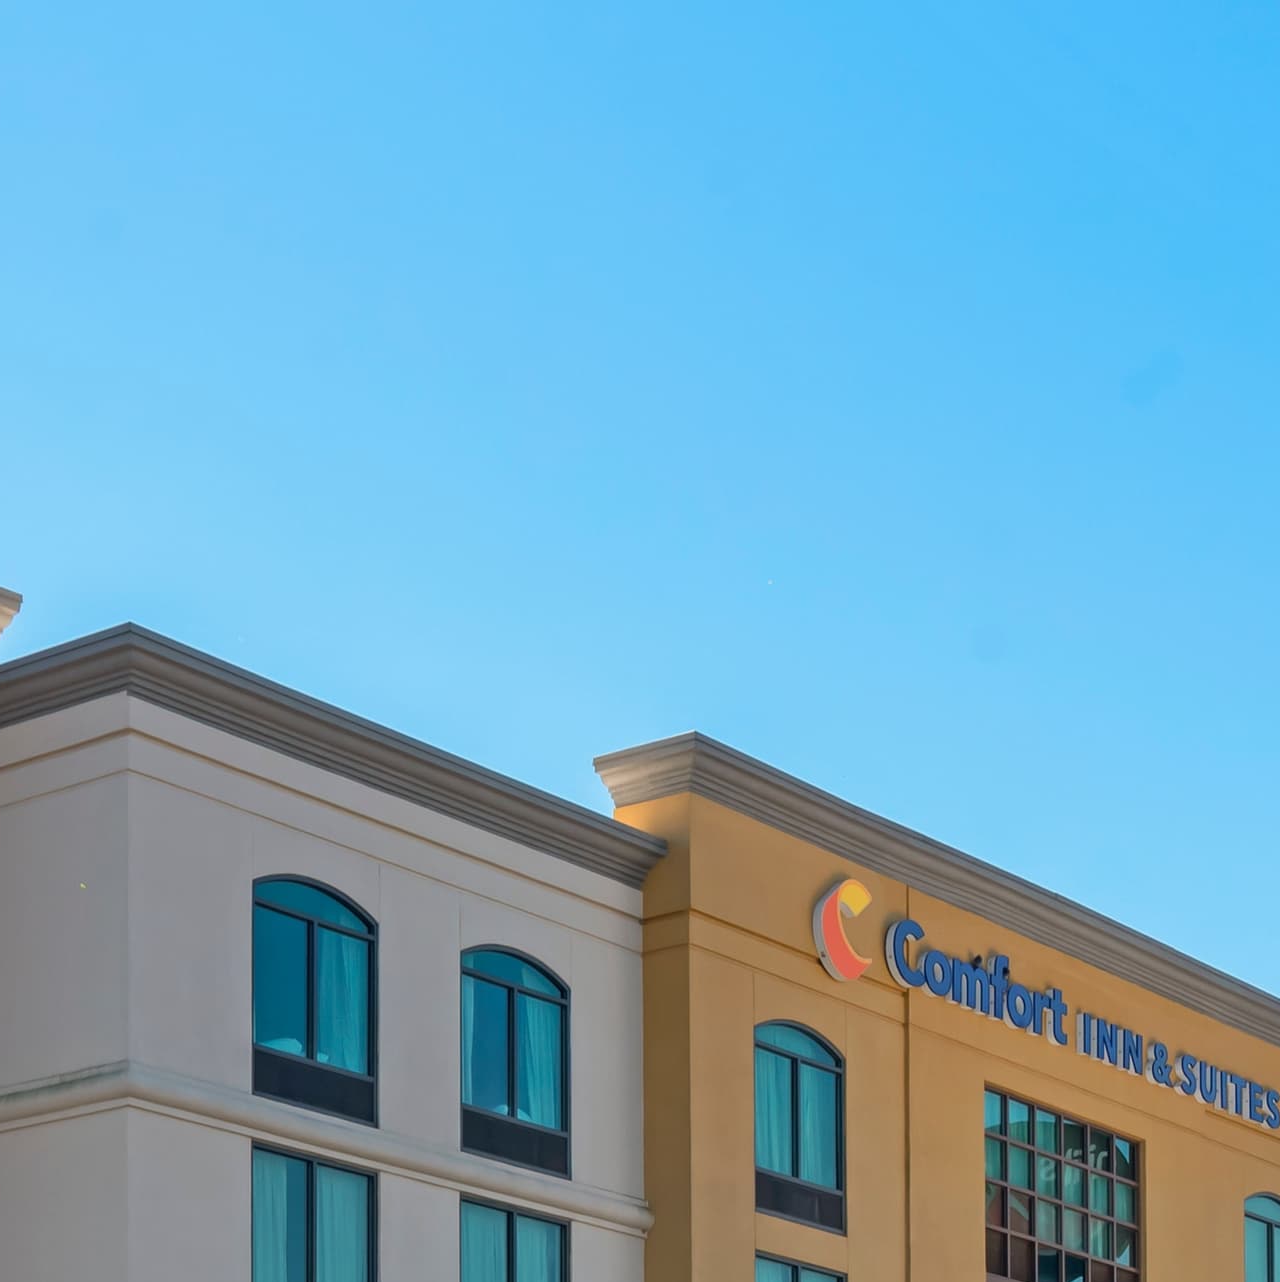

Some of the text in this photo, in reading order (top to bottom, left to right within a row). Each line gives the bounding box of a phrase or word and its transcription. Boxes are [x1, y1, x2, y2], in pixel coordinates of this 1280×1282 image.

[890, 918, 1068, 1045] Comfort
[1080, 1012, 1144, 1077] INN
[1149, 1042, 1175, 1088] &
